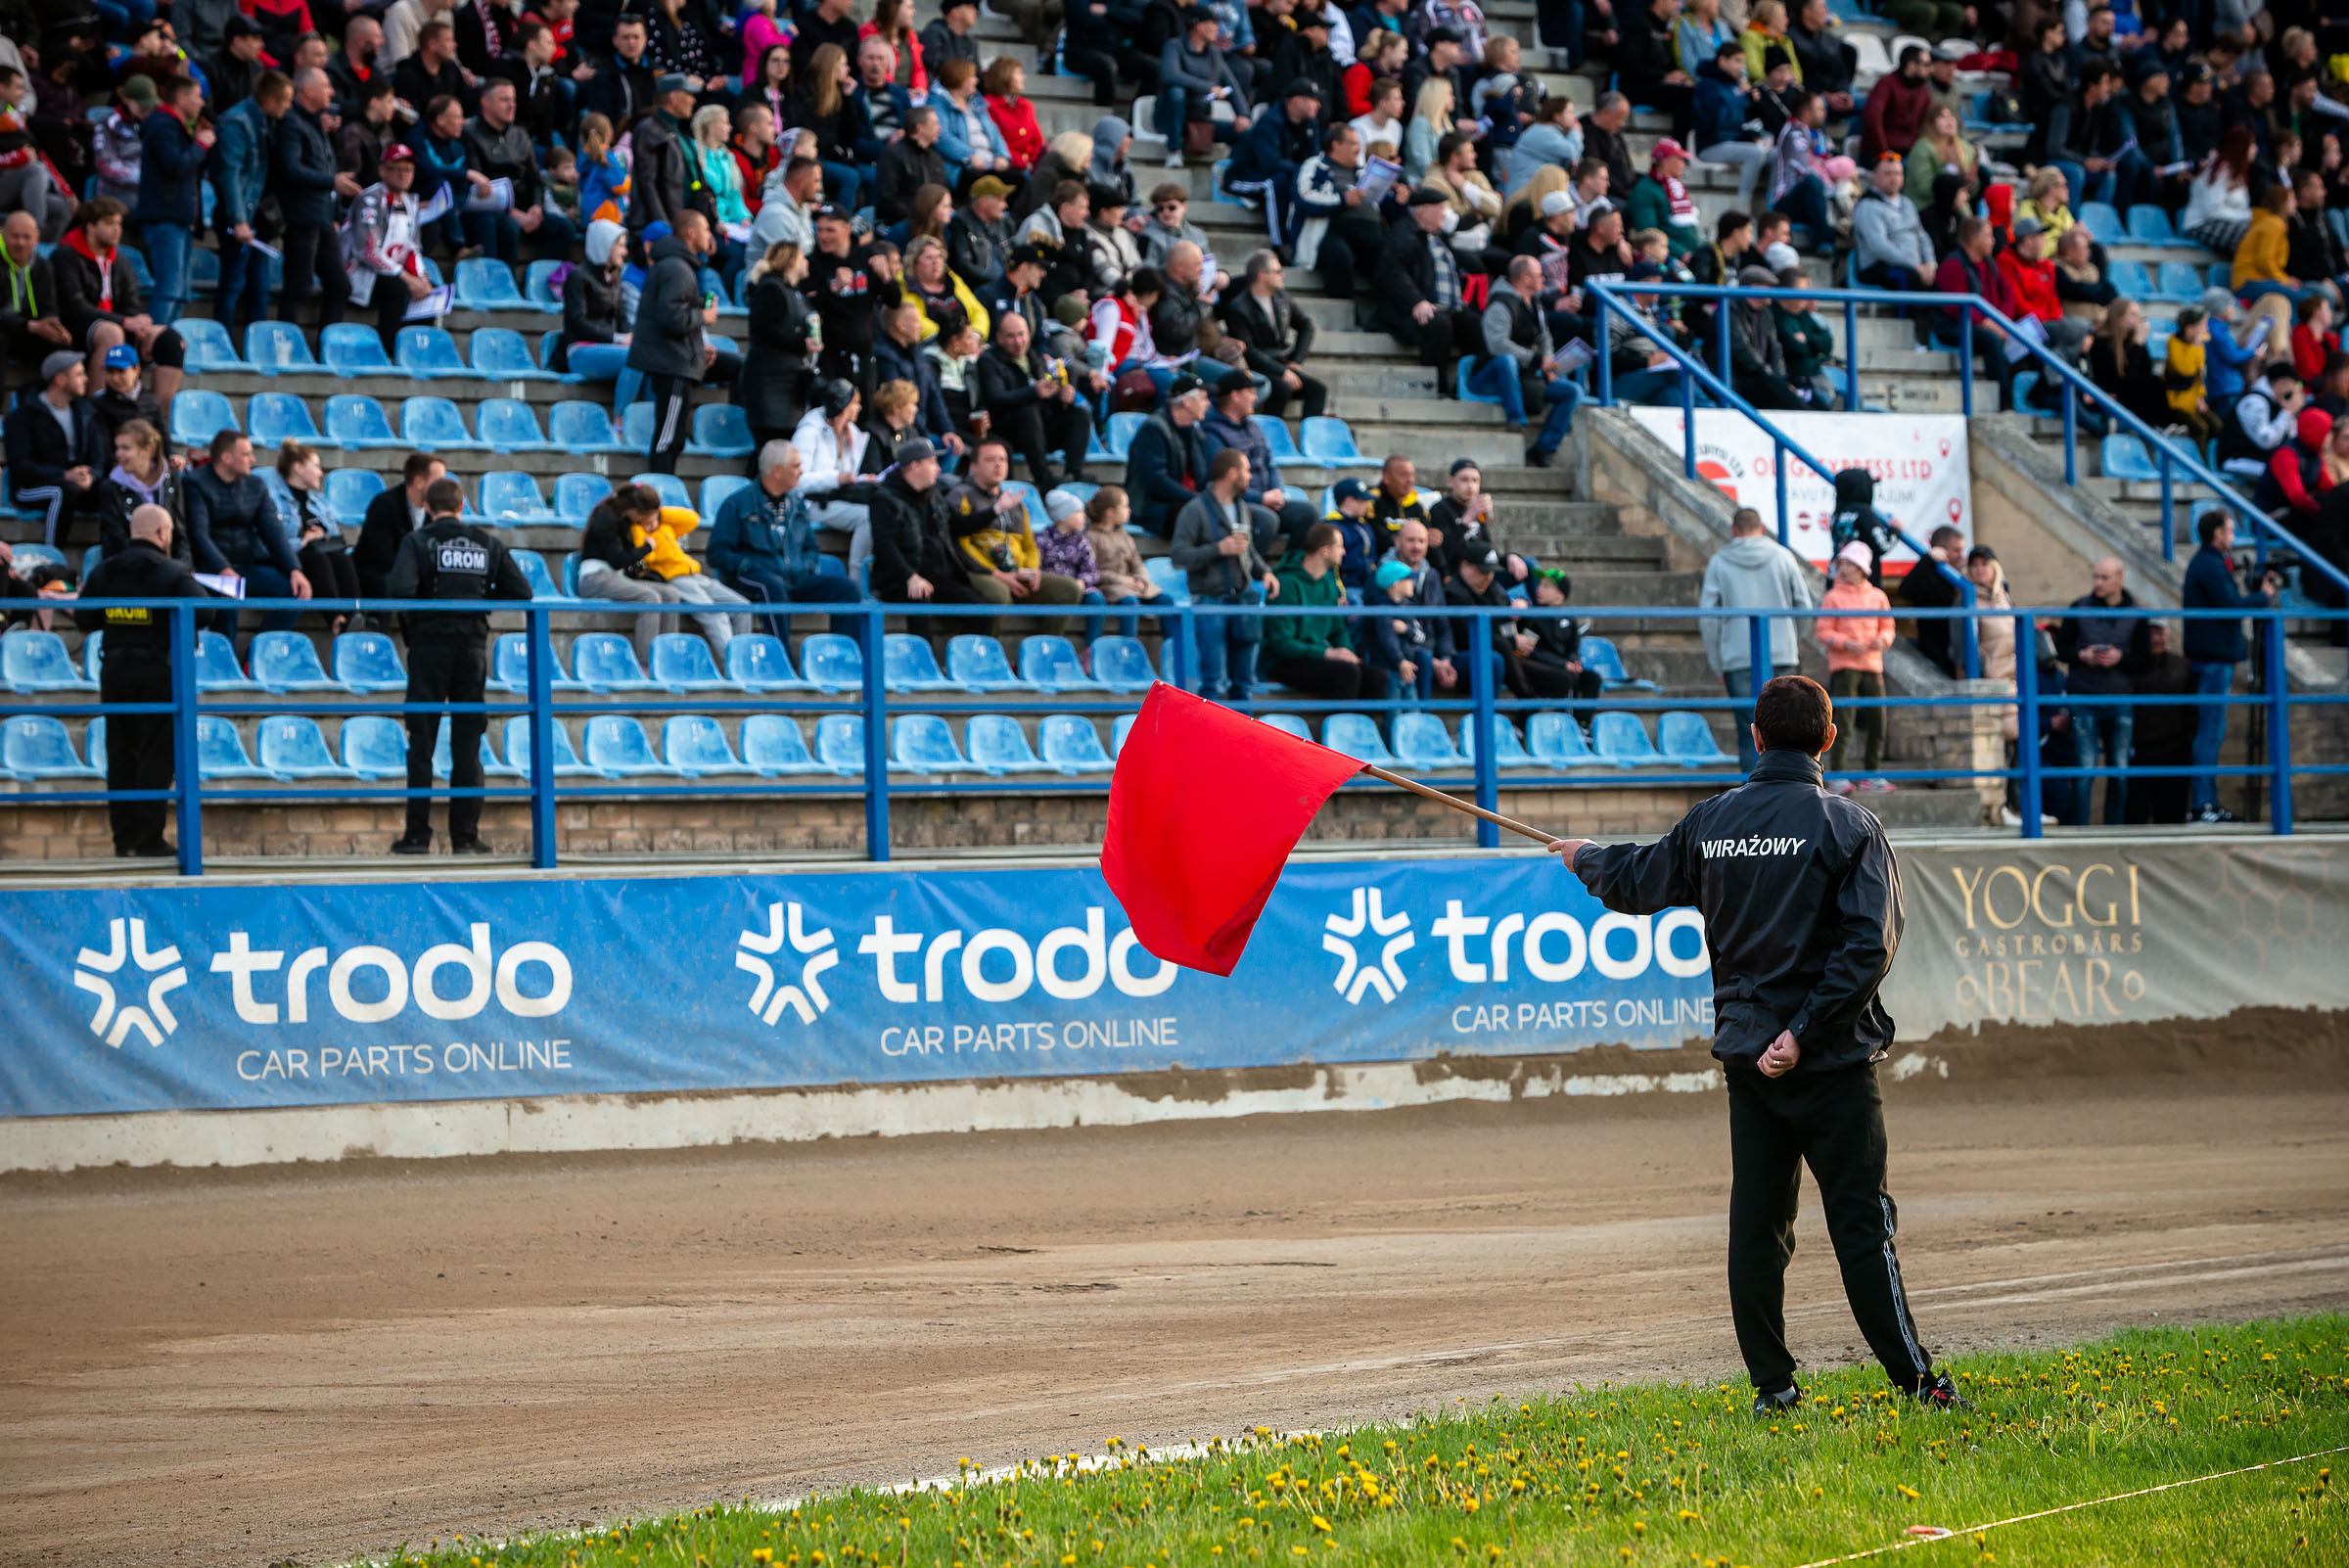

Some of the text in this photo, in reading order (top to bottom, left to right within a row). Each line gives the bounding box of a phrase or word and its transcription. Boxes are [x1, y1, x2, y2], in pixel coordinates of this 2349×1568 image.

[1901, 459, 1931, 481] LTD
[441, 550, 485, 570] GROM
[1701, 834, 1807, 858] WIRAŻOWY
[1952, 863, 2142, 929] YOGGI
[857, 906, 1178, 1003] trodo
[1431, 899, 1712, 983] trodo
[1956, 931, 2142, 957] GASTROBĀRS
[209, 922, 573, 1024] trodo
[1986, 957, 2123, 1019] BEAR
[1451, 996, 1714, 1034] CAR PARTS ONLINE
[880, 1017, 1178, 1056] CAR PARTS ONLINE
[236, 1038, 573, 1081] CAR PARTS ONLINE
